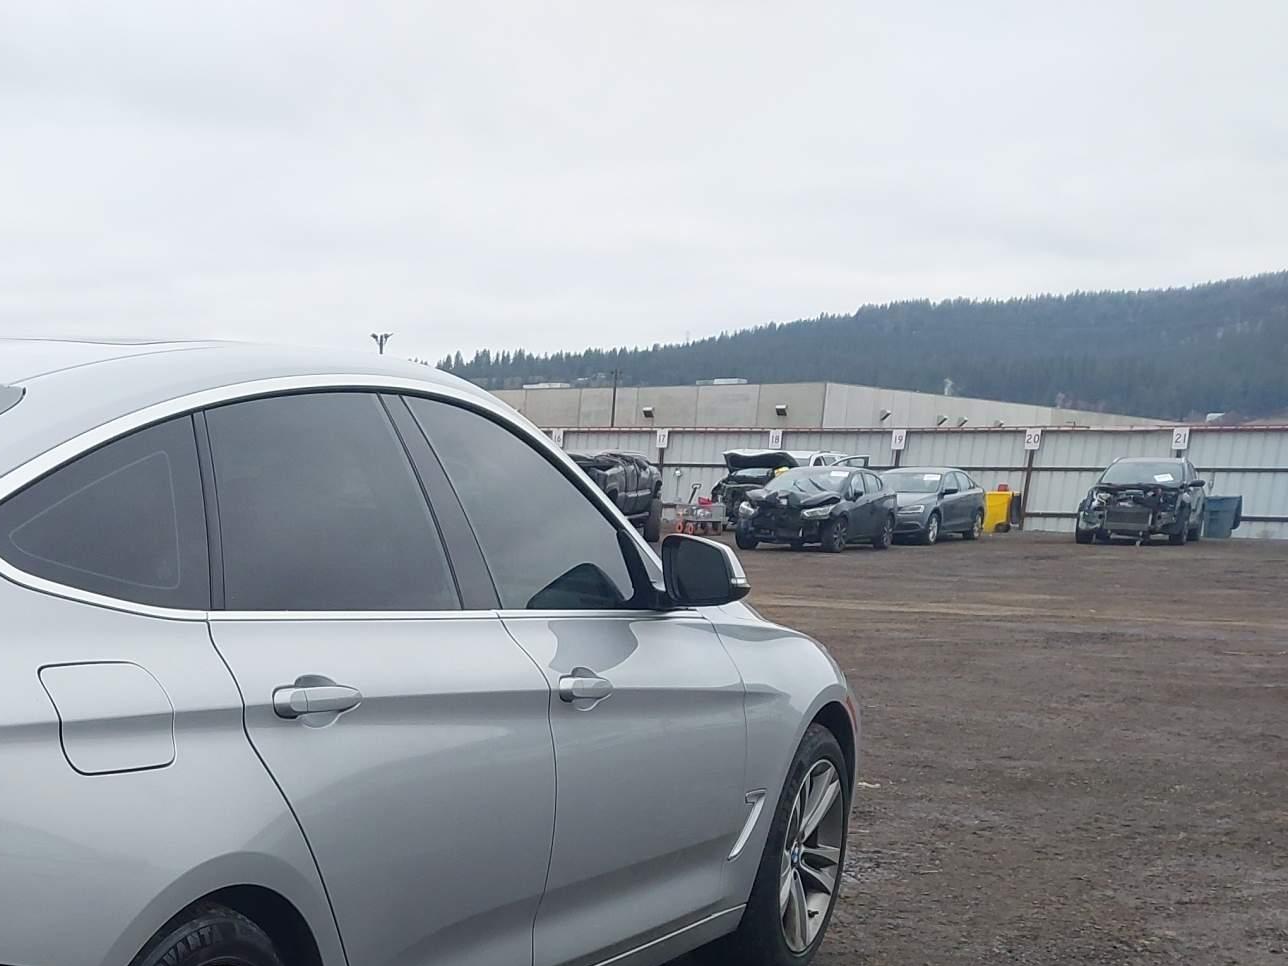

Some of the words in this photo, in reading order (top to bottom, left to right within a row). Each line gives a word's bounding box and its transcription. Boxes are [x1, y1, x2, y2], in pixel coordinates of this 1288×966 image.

[771, 435, 780, 444] 18
[894, 434, 904, 445] 19
[1026, 433, 1040, 444] 20
[1174, 432, 1187, 444] 21
